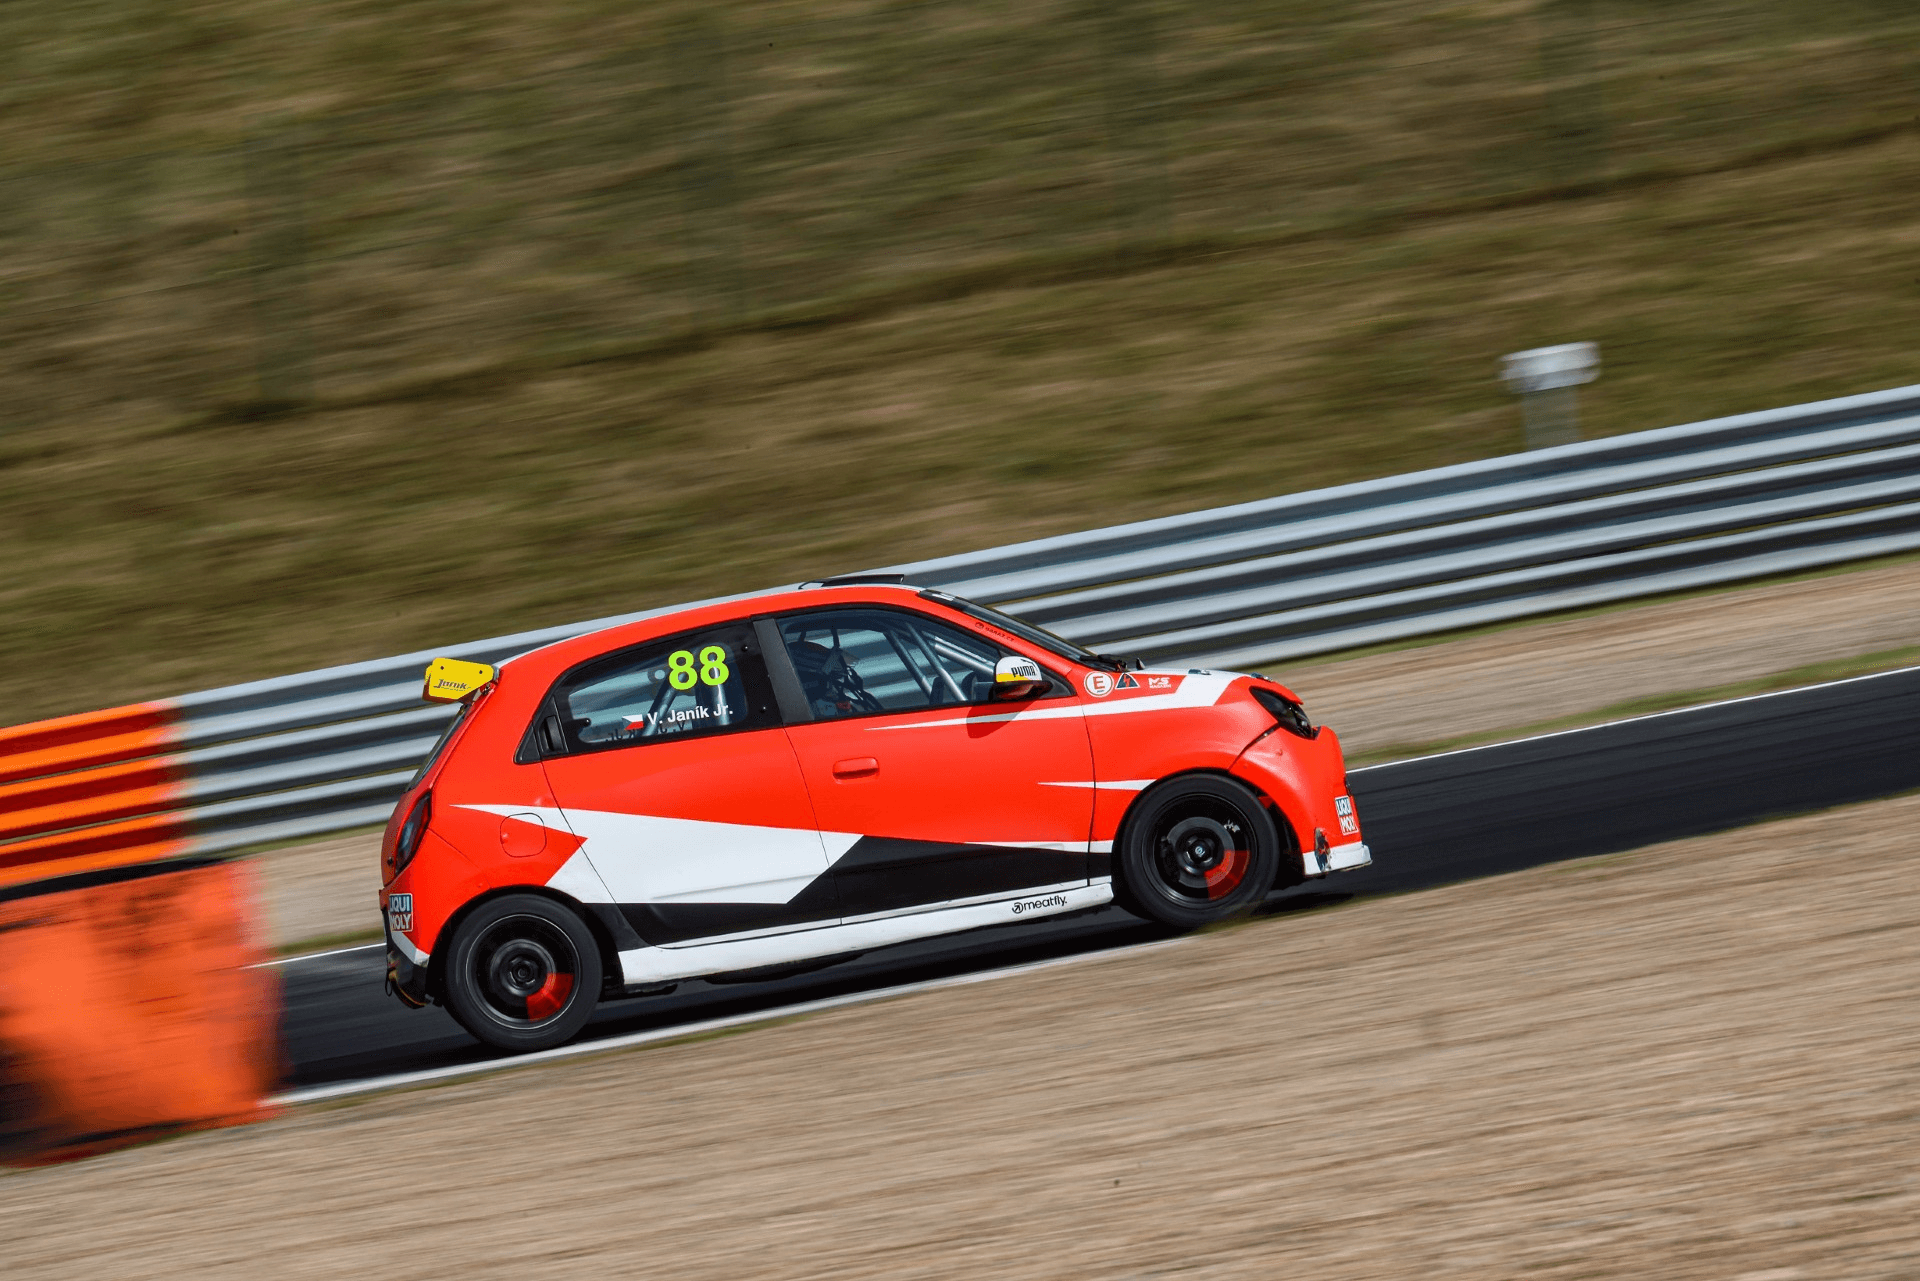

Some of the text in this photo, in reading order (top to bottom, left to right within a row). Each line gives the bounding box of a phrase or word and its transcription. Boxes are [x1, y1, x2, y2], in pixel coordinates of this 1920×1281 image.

[668, 645, 730, 691] 88
[1011, 665, 1036, 678] PUMA
[1093, 675, 1105, 689] E
[646, 703, 733, 725] V. Janík Jr.
